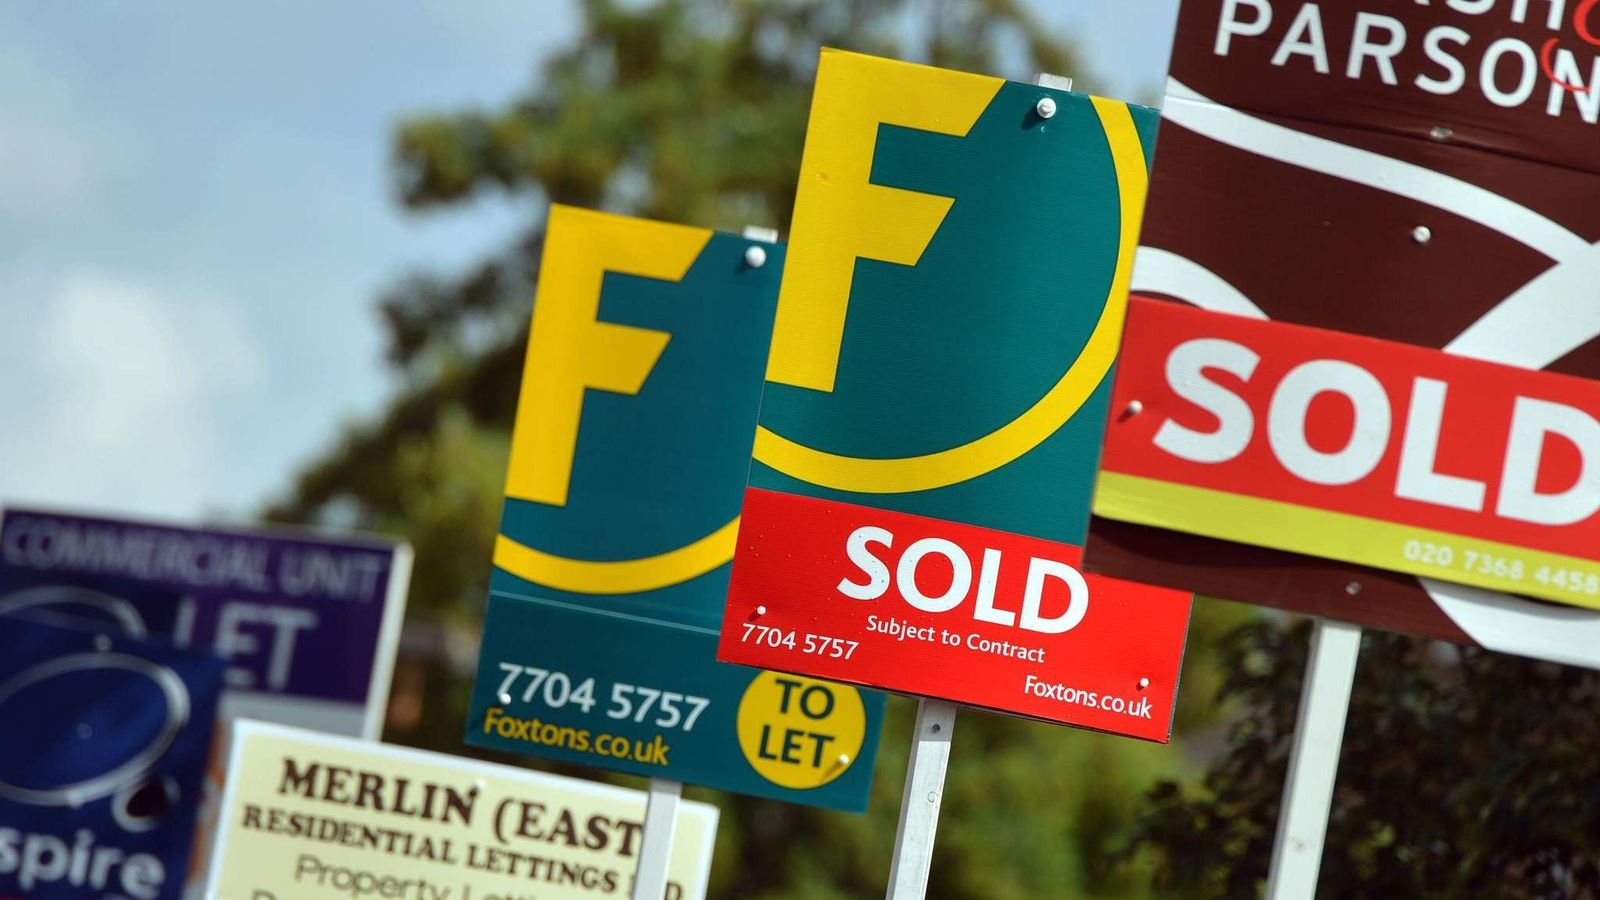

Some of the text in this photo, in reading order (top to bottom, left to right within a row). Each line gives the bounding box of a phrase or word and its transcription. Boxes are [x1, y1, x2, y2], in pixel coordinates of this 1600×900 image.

[1152, 337, 1600, 526] SOLD
[4, 516, 382, 602] COMMERCIAL UNIT
[837, 525, 1090, 634] SOLD
[1403, 540, 1600, 596] 020 7368 4458
[742, 622, 859, 661] 7704 5757
[866, 614, 1046, 664] Subject to Contract
[498, 662, 710, 732] 7704 5757
[775, 678, 834, 720] TO
[1024, 674, 1153, 720] Foxtons.co.uk
[483, 707, 671, 767] Foxtons.co.uk
[757, 724, 834, 769] LET
[278, 759, 480, 825] MERLIN
[242, 805, 455, 864] RESIDENTIAL
[466, 845, 619, 892] LETTINGS
